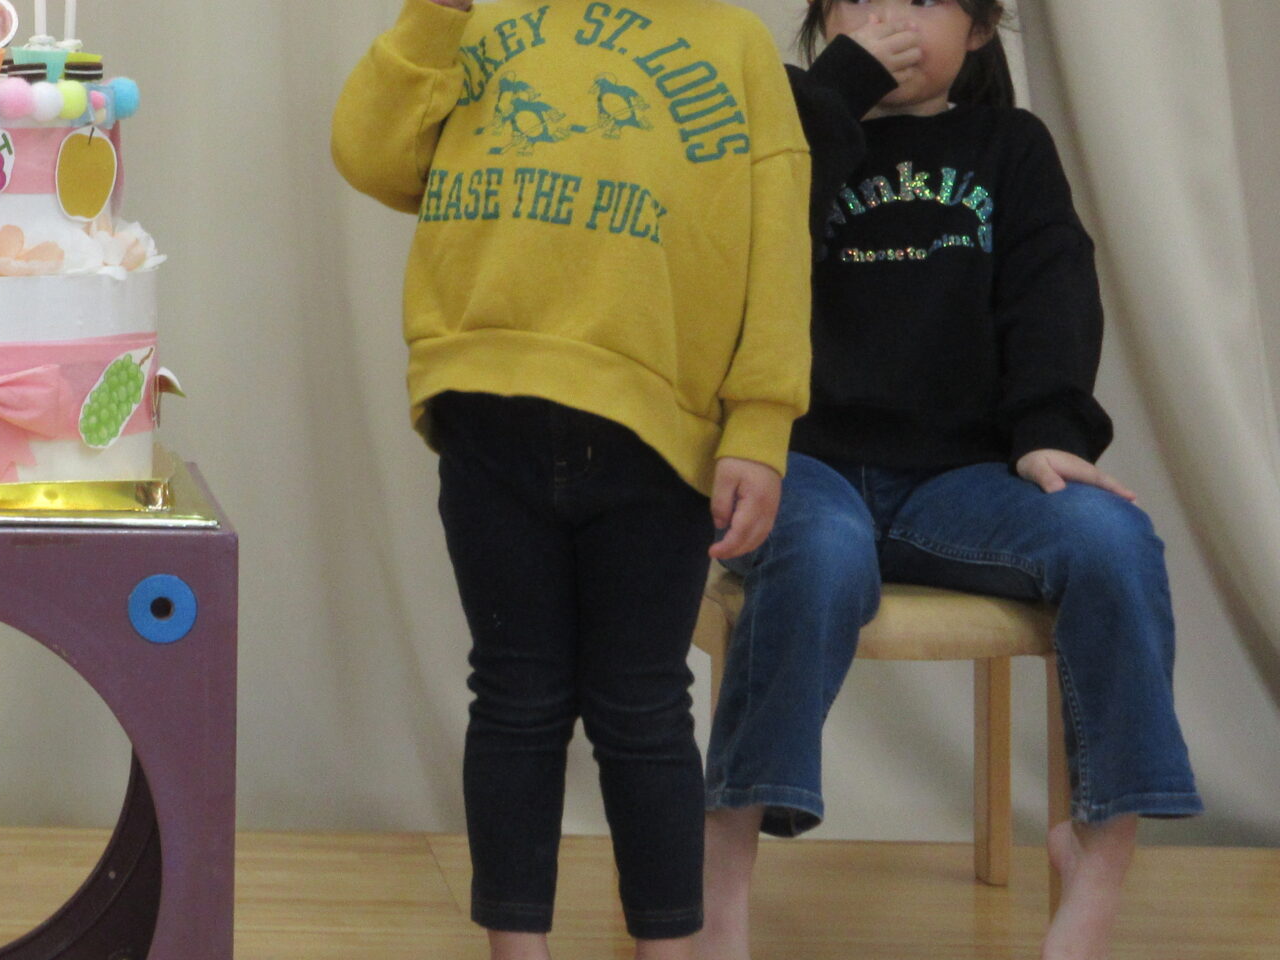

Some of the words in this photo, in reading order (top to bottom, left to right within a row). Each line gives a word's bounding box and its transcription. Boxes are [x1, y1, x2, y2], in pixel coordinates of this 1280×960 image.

[574, 1, 653, 54] ST.
[632, 37, 751, 164] LOUIS
[418, 167, 504, 222] HASE
[512, 167, 582, 226] THE
